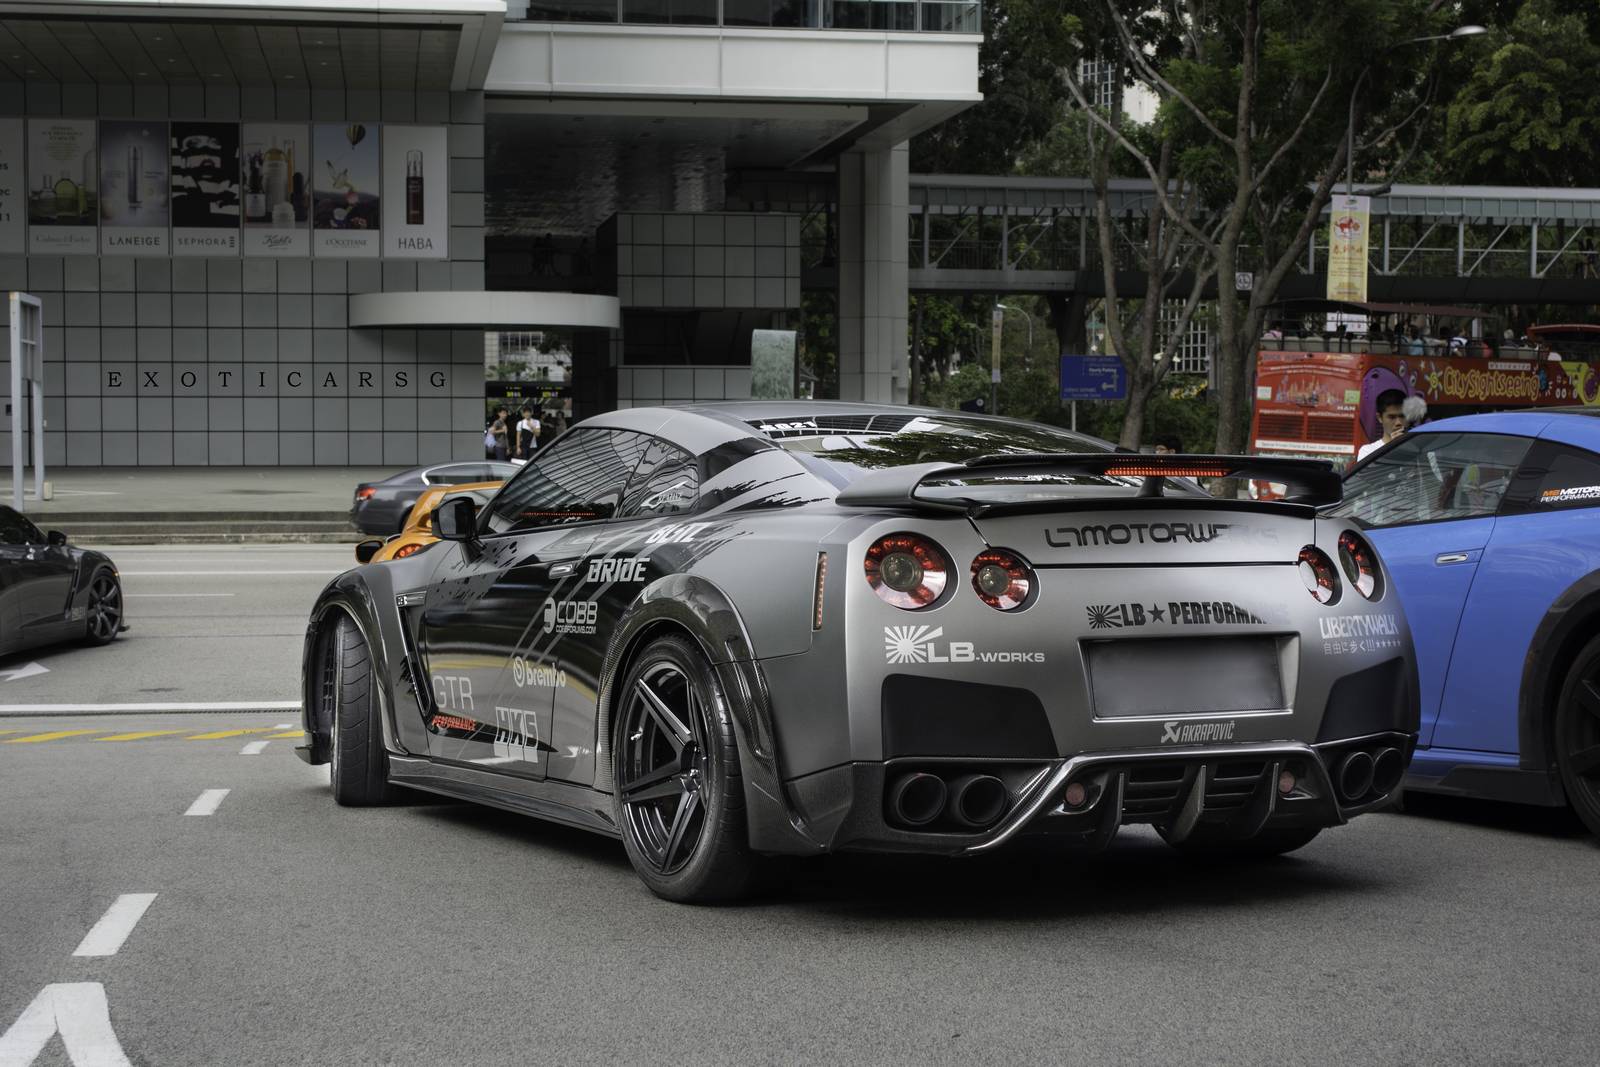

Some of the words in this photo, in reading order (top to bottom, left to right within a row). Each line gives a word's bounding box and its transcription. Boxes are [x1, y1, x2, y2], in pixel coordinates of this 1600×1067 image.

[108, 236, 161, 247] LANEIGE
[177, 237, 227, 247] SEPHORA
[397, 237, 434, 250] HABA
[586, 557, 651, 583] BRIDE
[557, 601, 598, 625] COBB
[1119, 603, 1147, 628] LB
[525, 661, 567, 688] brembo
[431, 675, 474, 711] GTR
